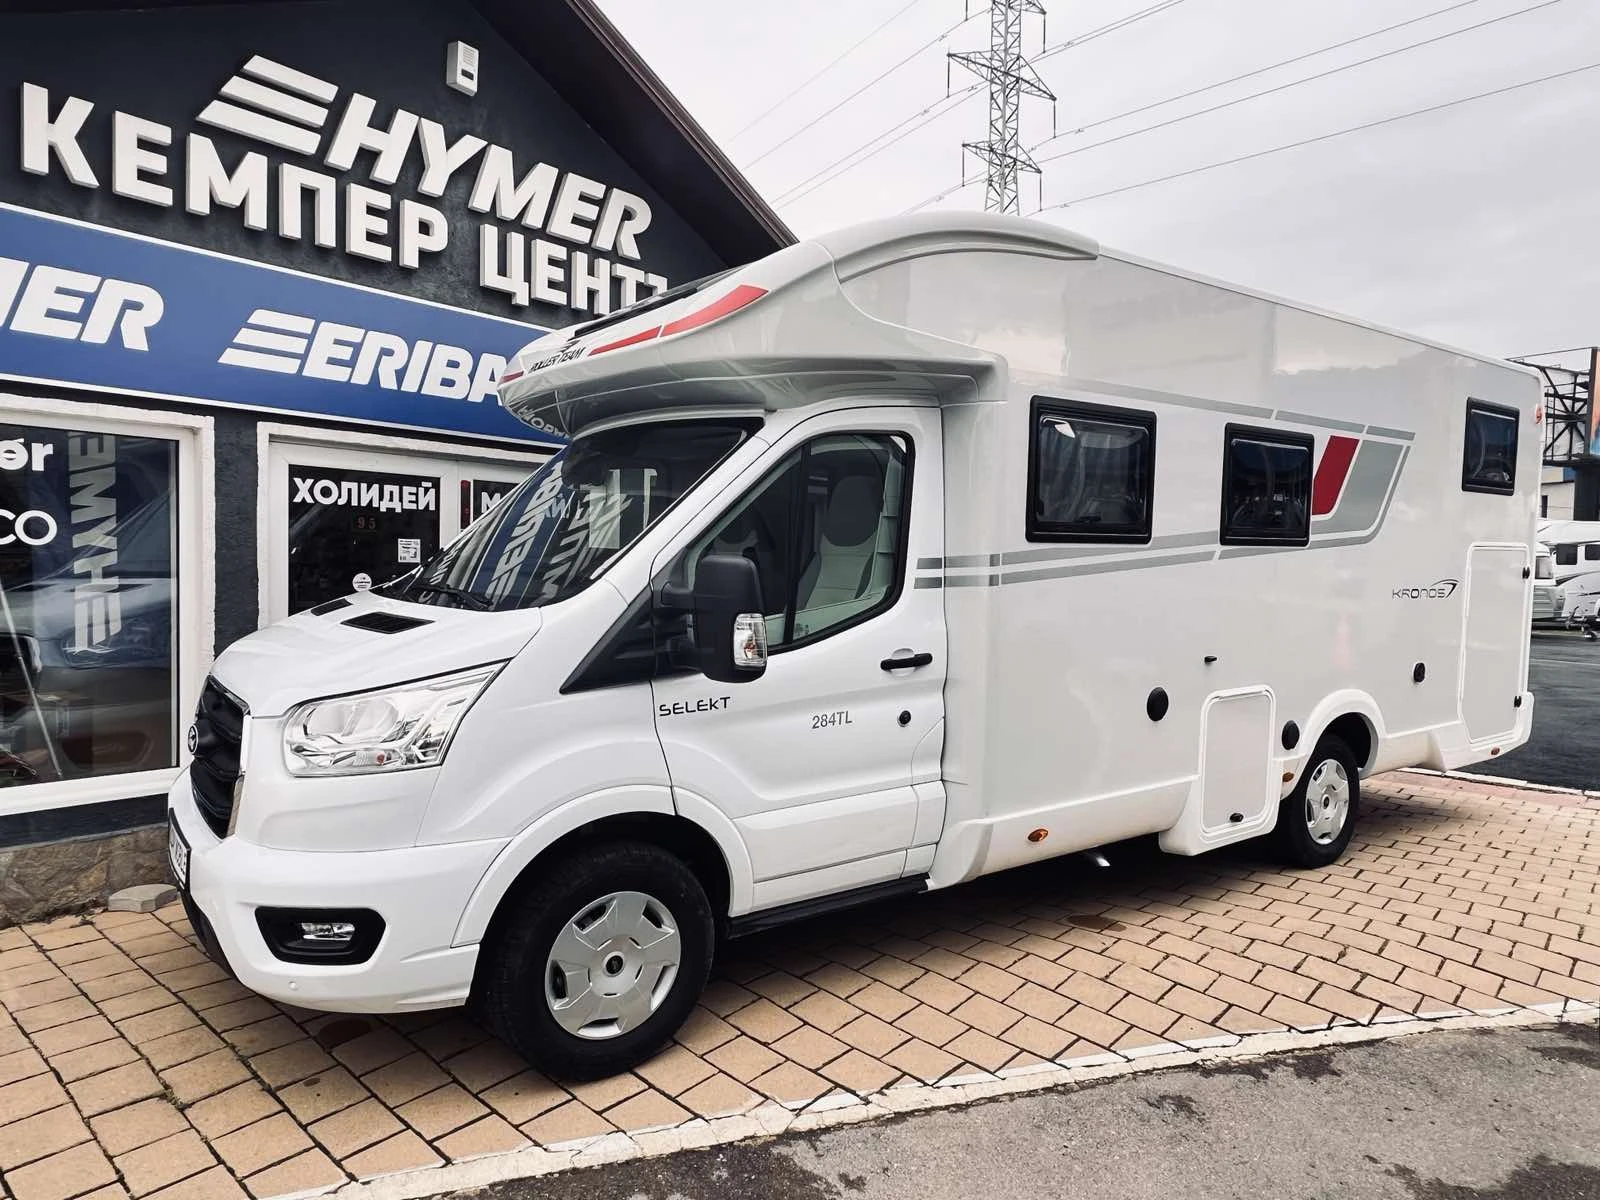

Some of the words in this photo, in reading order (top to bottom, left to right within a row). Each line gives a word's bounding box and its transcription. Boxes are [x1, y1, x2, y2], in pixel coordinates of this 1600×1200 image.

[20, 81, 449, 269] КЕМПЕР
[324, 93, 652, 260] HYMER
[293, 477, 436, 512] ХОЛИДЕЙ
[659, 696, 731, 717] SELEKT
[811, 710, 853, 730] 284TL
